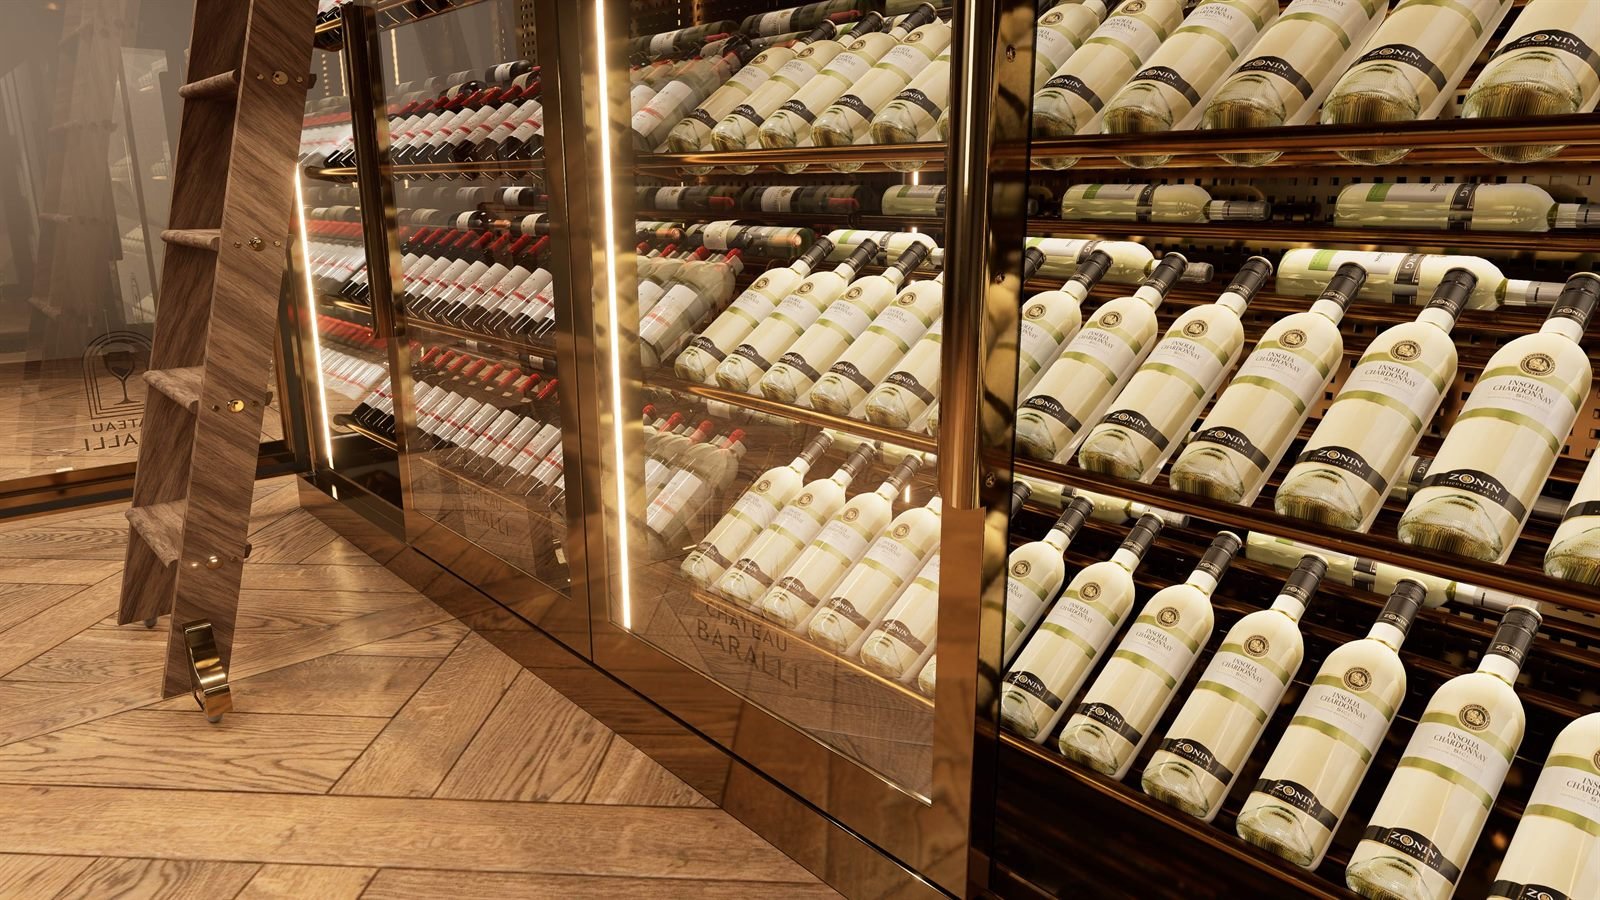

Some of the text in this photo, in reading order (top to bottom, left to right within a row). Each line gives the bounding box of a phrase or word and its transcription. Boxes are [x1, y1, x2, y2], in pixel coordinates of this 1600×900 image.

[1519, 33, 1579, 48] ZONIN
[1369, 47, 1421, 61] ZONIN
[1244, 59, 1289, 72] ZONIN
[1556, 308, 1587, 322] ZONIN
[1267, 351, 1296, 364] INSOLIA
[1364, 369, 1417, 389] CHARDONNAY
[1378, 364, 1410, 379] INSOLIA
[1491, 385, 1555, 406] CHARDONNAY
[1507, 379, 1545, 395] INSOLIA
[1028, 398, 1062, 413] ZONIN
[1112, 412, 1148, 429] ZONIN
[1207, 430, 1248, 447] ZONIN
[1318, 449, 1364, 469] ZONIN
[1448, 472, 1502, 494] ZONIN
[705, 604, 788, 651] CHATEAU
[696, 618, 798, 690] BARALLI
[1495, 645, 1523, 660] ZONIN
[1013, 672, 1044, 691] ZONIN
[1320, 695, 1369, 720] CHARDONNAY
[1332, 691, 1361, 710] INSOLIA
[1090, 704, 1123, 725] ZONIN
[1433, 735, 1489, 762] CHARDONNAY
[1447, 730, 1480, 751] INSOLIA
[1175, 741, 1213, 764] ZONIN
[1566, 781, 1600, 798] CHARD
[1582, 777, 1600, 790] INS
[1275, 782, 1317, 808] ZONIN
[1389, 830, 1438, 860] ZONIN
